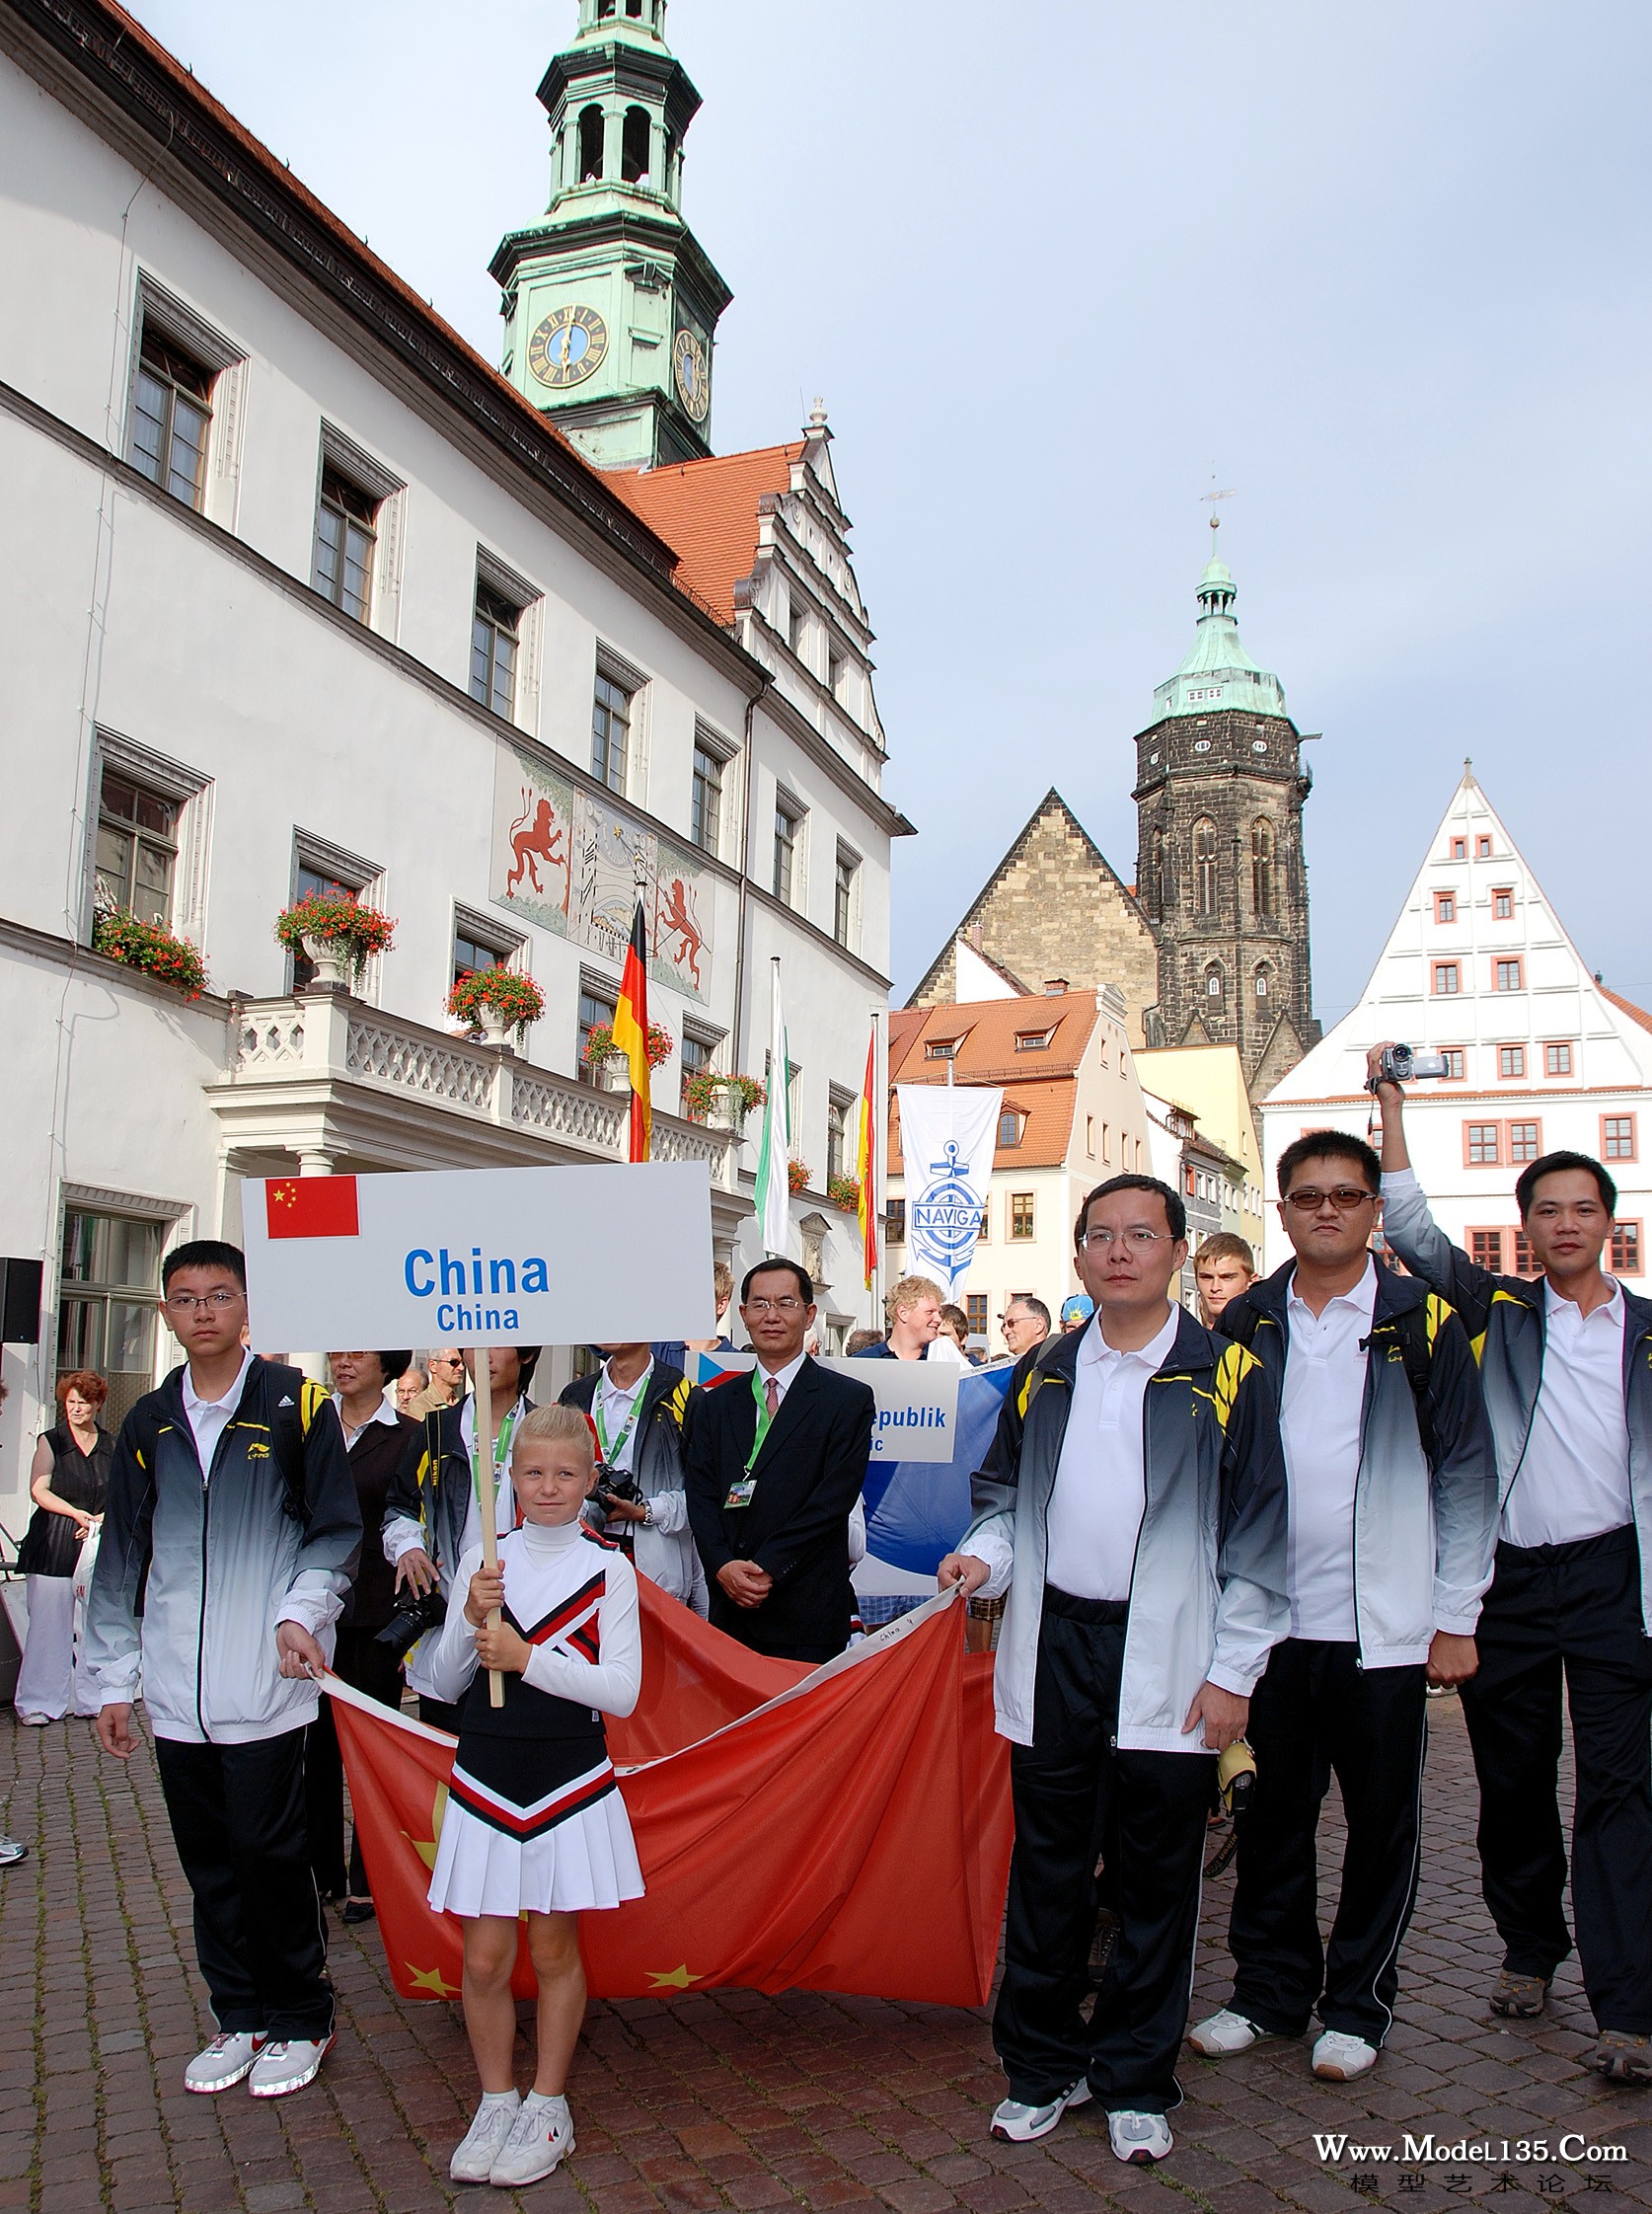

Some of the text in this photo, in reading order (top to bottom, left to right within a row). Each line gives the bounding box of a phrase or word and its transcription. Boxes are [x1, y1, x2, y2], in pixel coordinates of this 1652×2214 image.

[916, 1208, 982, 1226] NAVIGA
[404, 1247, 550, 1298] China
[436, 1303, 520, 1332] China
